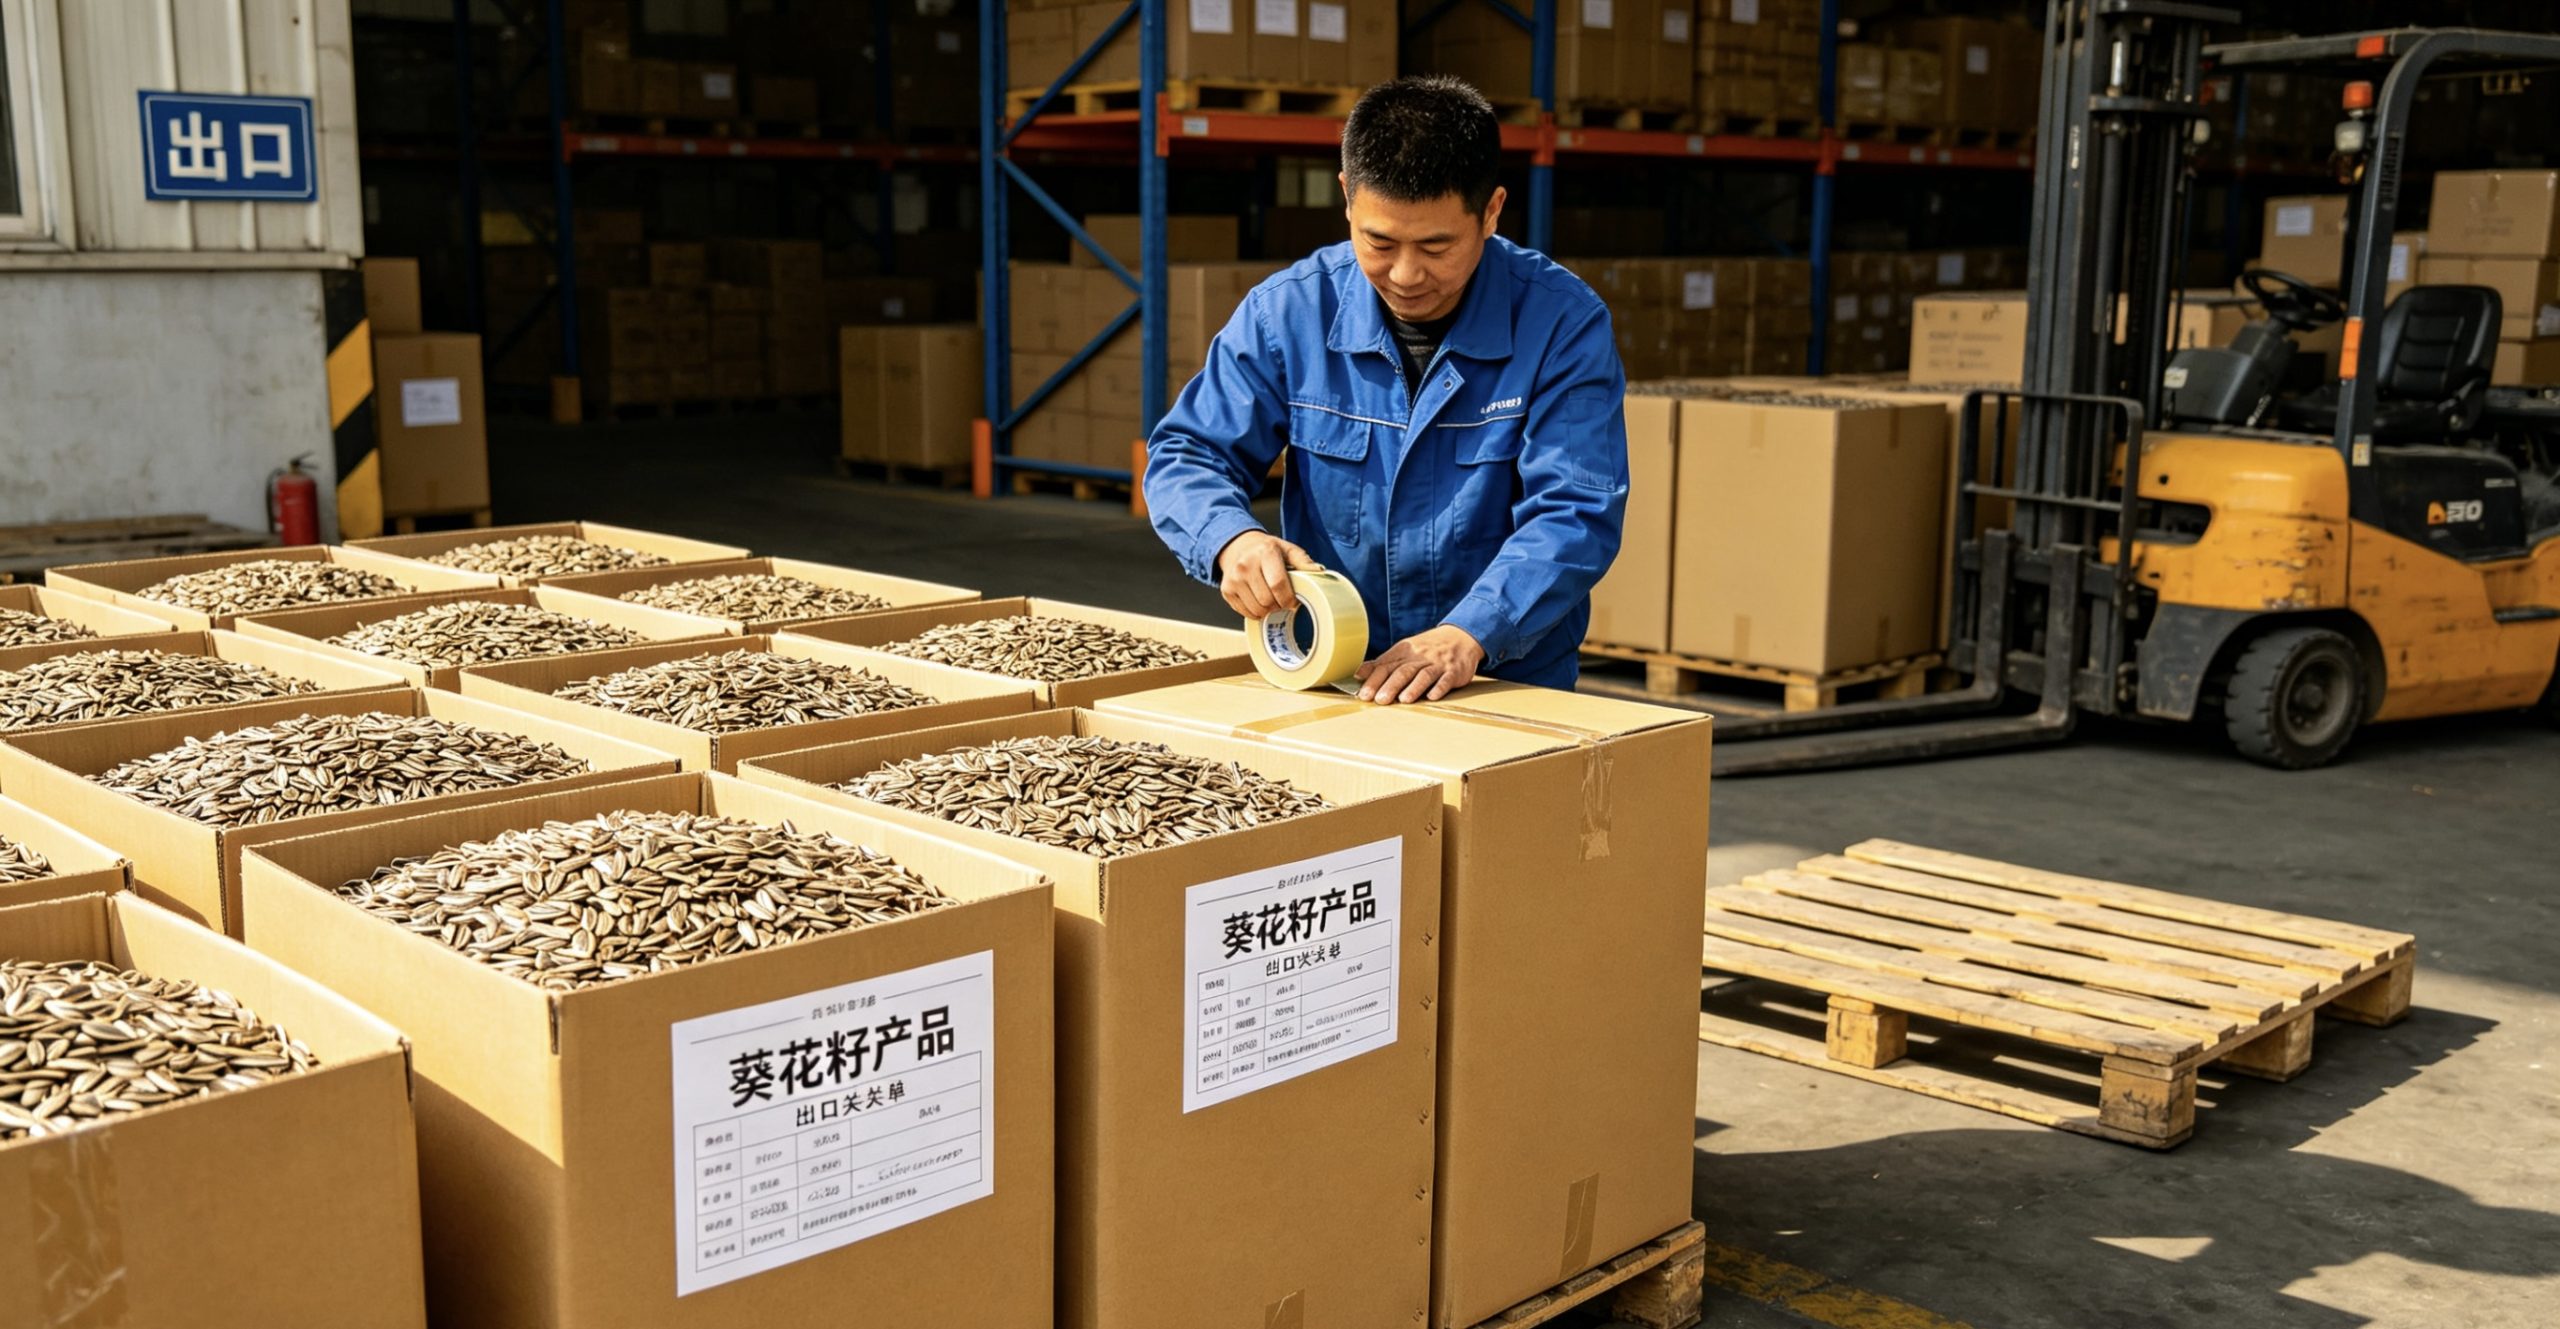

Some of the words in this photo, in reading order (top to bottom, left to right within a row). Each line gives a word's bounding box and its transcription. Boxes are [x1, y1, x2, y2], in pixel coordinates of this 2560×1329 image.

[168, 111, 292, 181] 出口
[1222, 879, 1376, 960] 葵花籽产品
[729, 1005, 954, 1109] 葵花籽产品
